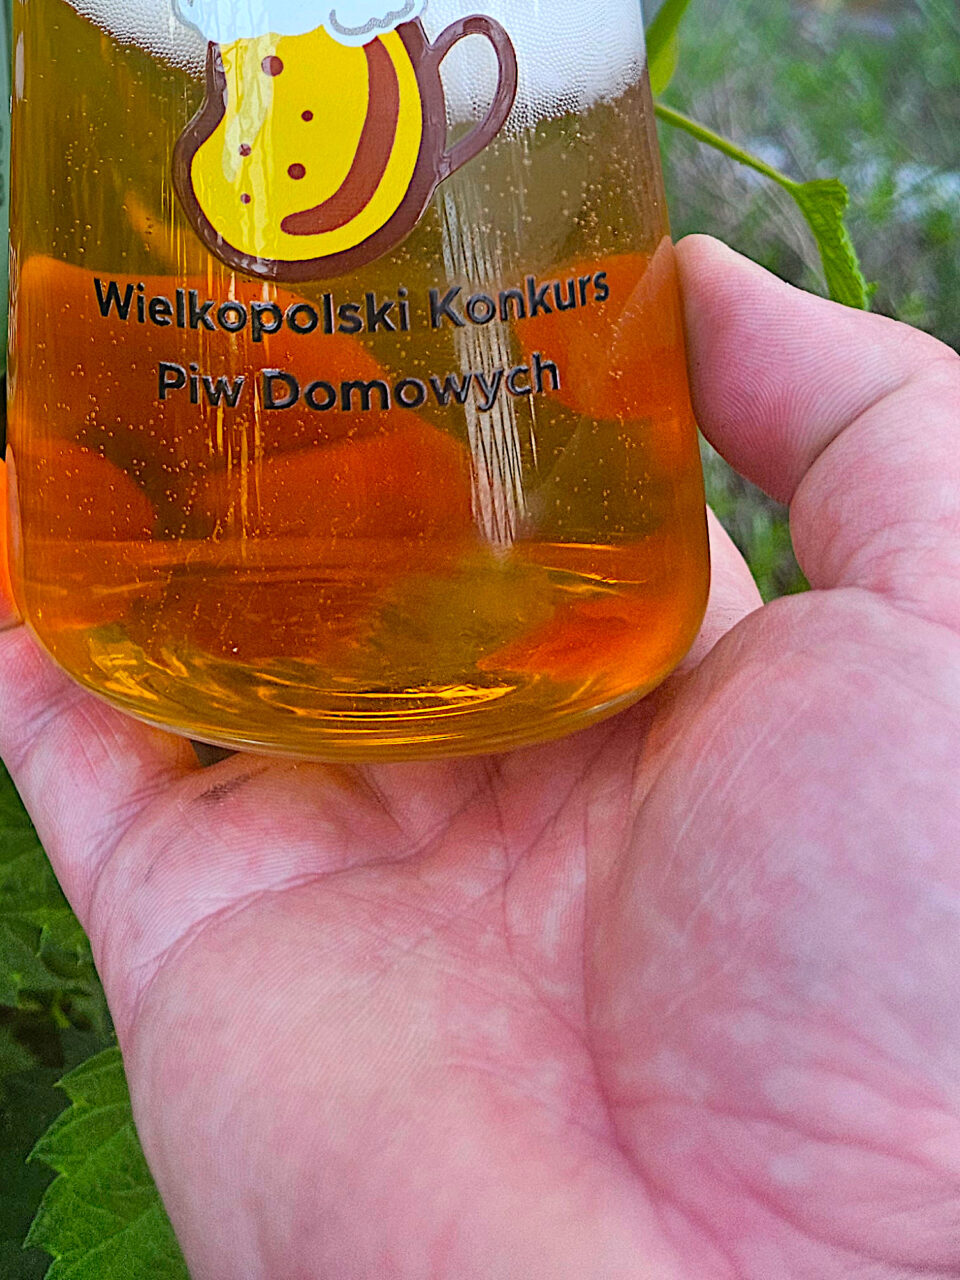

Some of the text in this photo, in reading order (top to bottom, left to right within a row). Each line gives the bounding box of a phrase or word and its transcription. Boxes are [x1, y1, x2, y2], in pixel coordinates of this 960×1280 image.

[93, 266, 610, 342] Wielkopolski Konkurs
[157, 352, 562, 413] Piw Domowych
